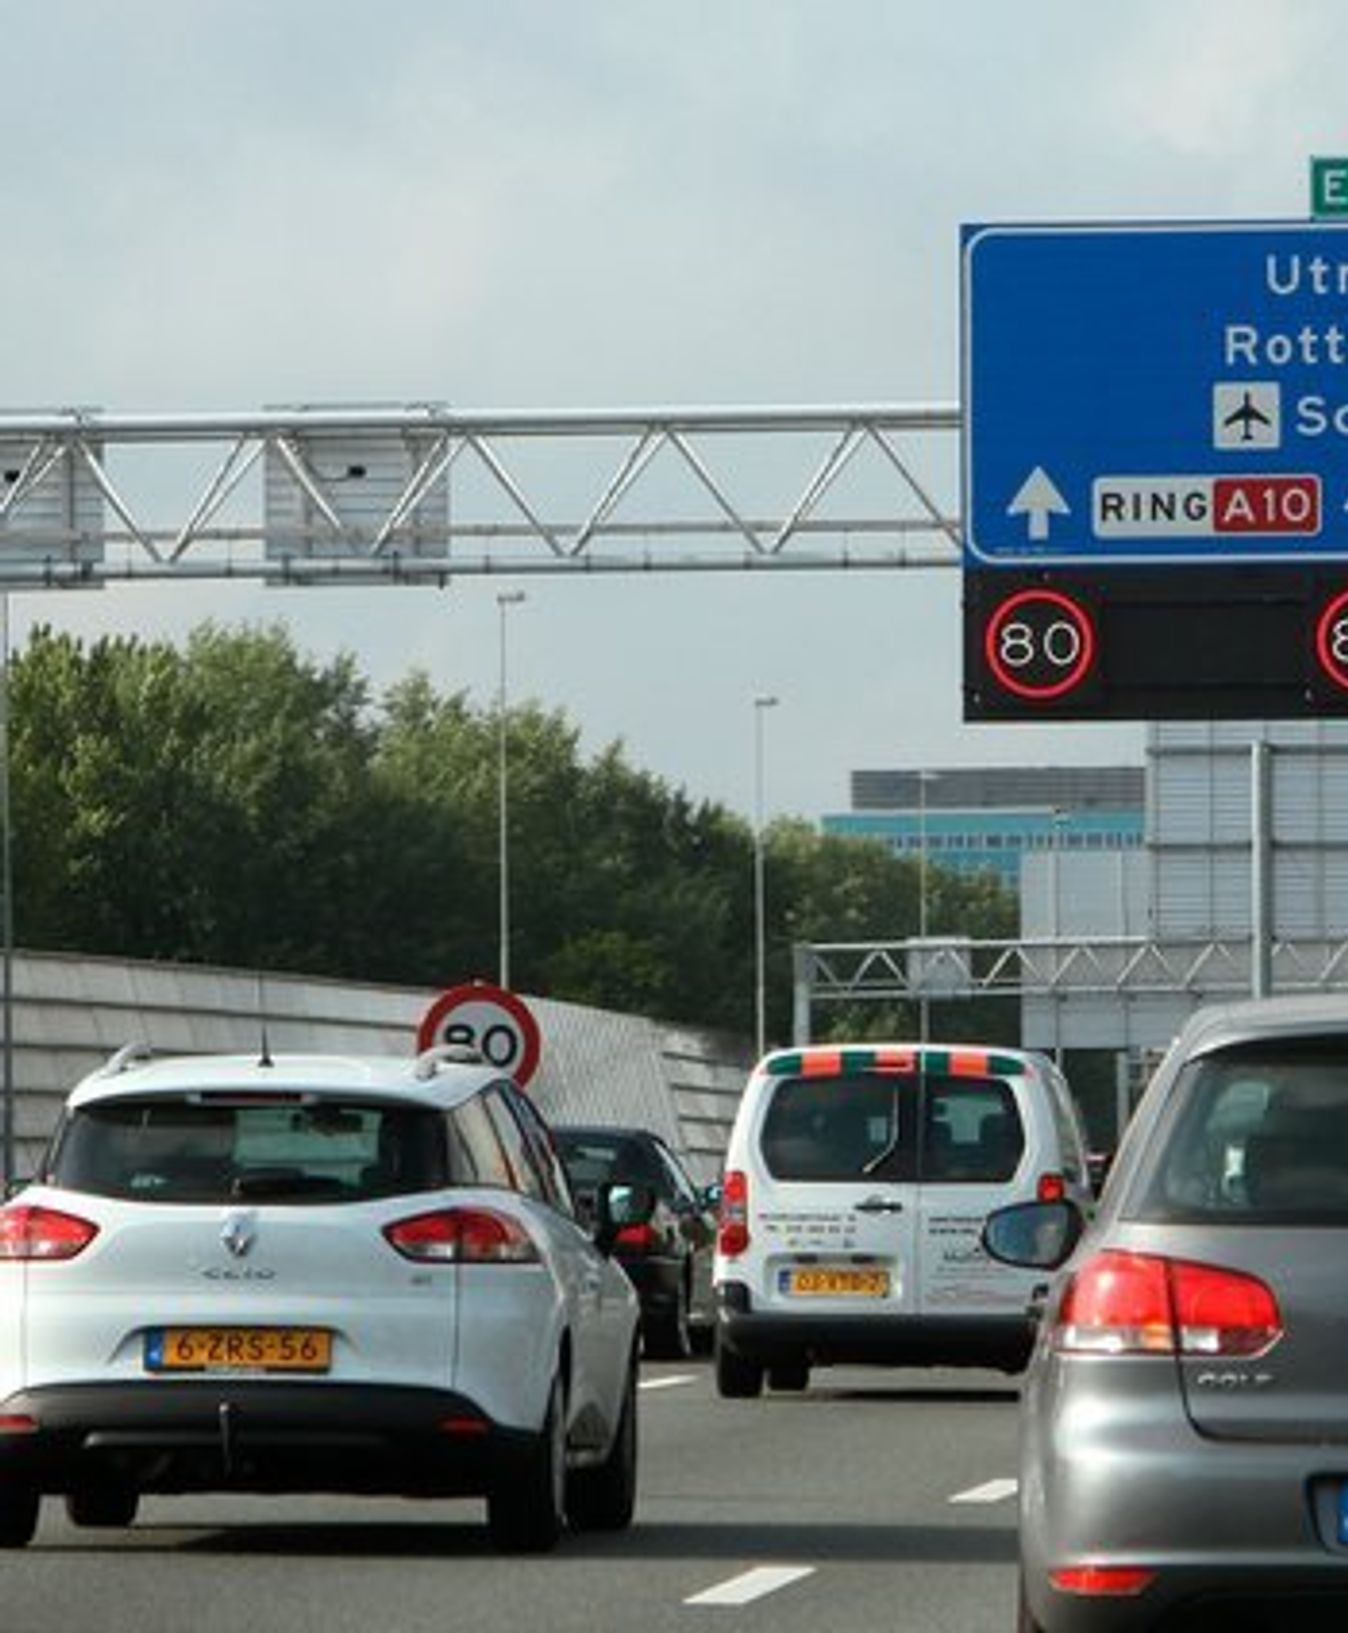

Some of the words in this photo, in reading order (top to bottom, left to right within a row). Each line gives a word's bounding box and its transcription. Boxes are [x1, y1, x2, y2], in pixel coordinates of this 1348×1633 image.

[1323, 169, 1348, 205] E
[1100, 491, 1207, 522] RING
[1223, 487, 1311, 523] A10
[1000, 621, 1080, 667] 80
[176, 1331, 318, 1361] 6-ZRS-56
